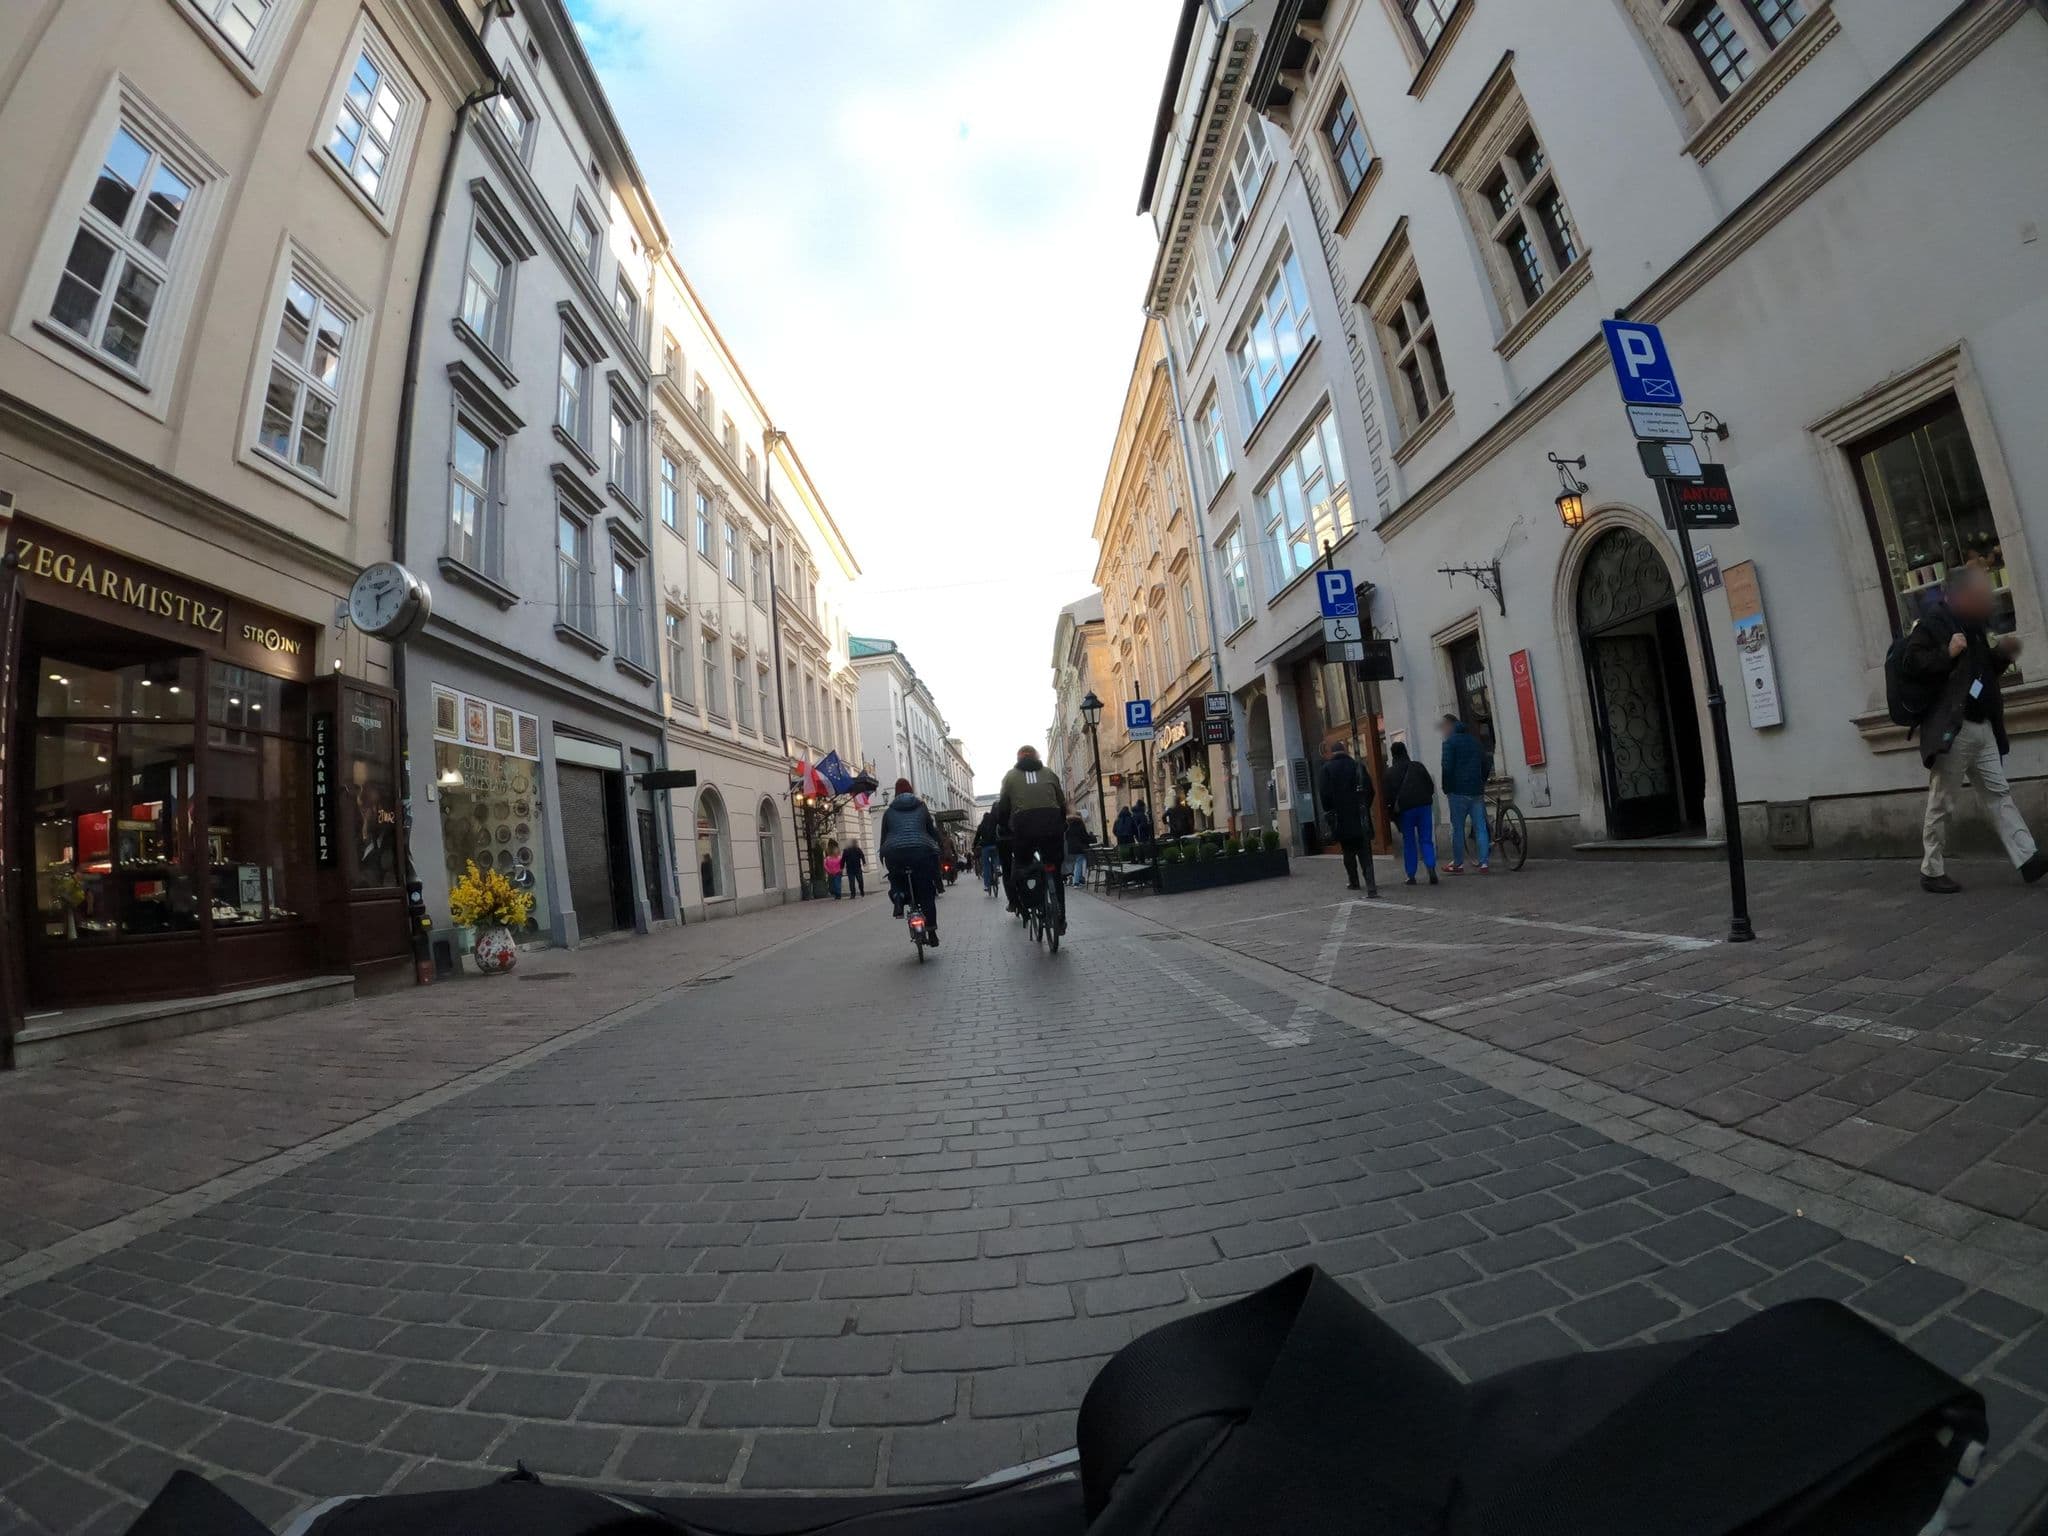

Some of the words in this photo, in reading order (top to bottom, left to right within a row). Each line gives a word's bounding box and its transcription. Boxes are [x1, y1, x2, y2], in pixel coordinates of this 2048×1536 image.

[1617, 328, 1656, 378] P
[1682, 487, 1729, 502] ANTOR
[1683, 503, 1732, 513] xchange
[16, 538, 223, 632] ZEGARMISTRZ
[1324, 574, 1347, 604] P
[1702, 573, 1715, 589] 14
[243, 624, 301, 655] STROJNY
[1465, 671, 1487, 692] KANT
[1131, 703, 1146, 724] P
[316, 720, 328, 860] ZEGARMISTRZ
